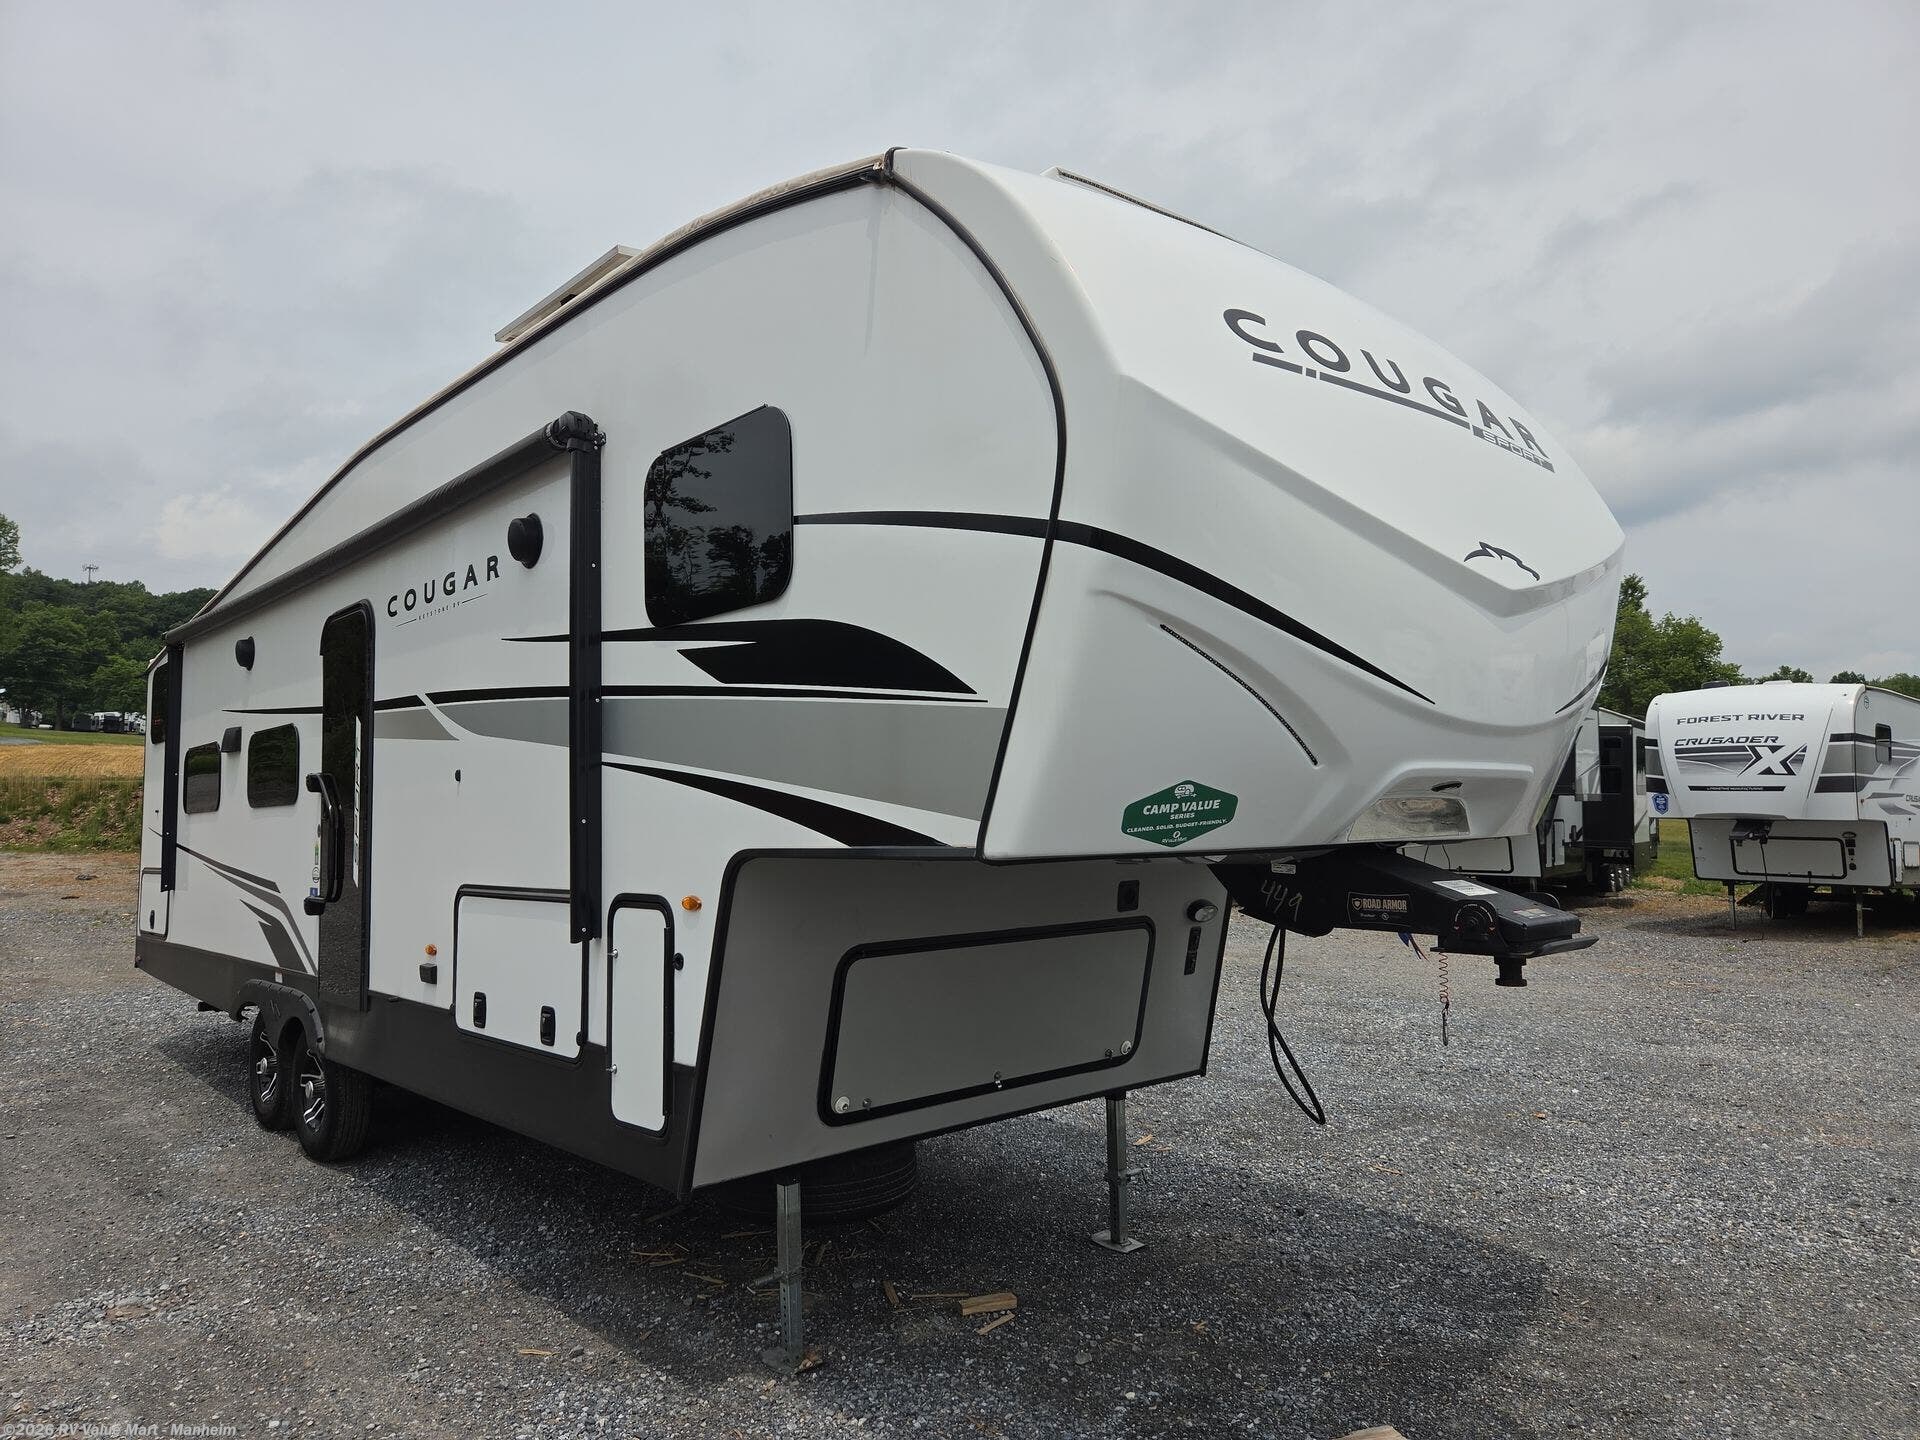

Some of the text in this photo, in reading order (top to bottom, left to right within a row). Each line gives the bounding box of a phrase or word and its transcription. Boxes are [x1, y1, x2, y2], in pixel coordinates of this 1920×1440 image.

[1223, 308, 1549, 459] COUGAR
[1482, 429, 1545, 467] SPORT
[387, 555, 500, 617] COUGAR
[1676, 713, 1805, 725] FOREST RIVER
[1674, 735, 1779, 746] CRUSADER
[1143, 799, 1221, 815] CAMP VALUE
[1169, 812, 1195, 820] SERIES
[1261, 879, 1303, 922] 449
[1362, 898, 1407, 911] ROAD ARMOR
